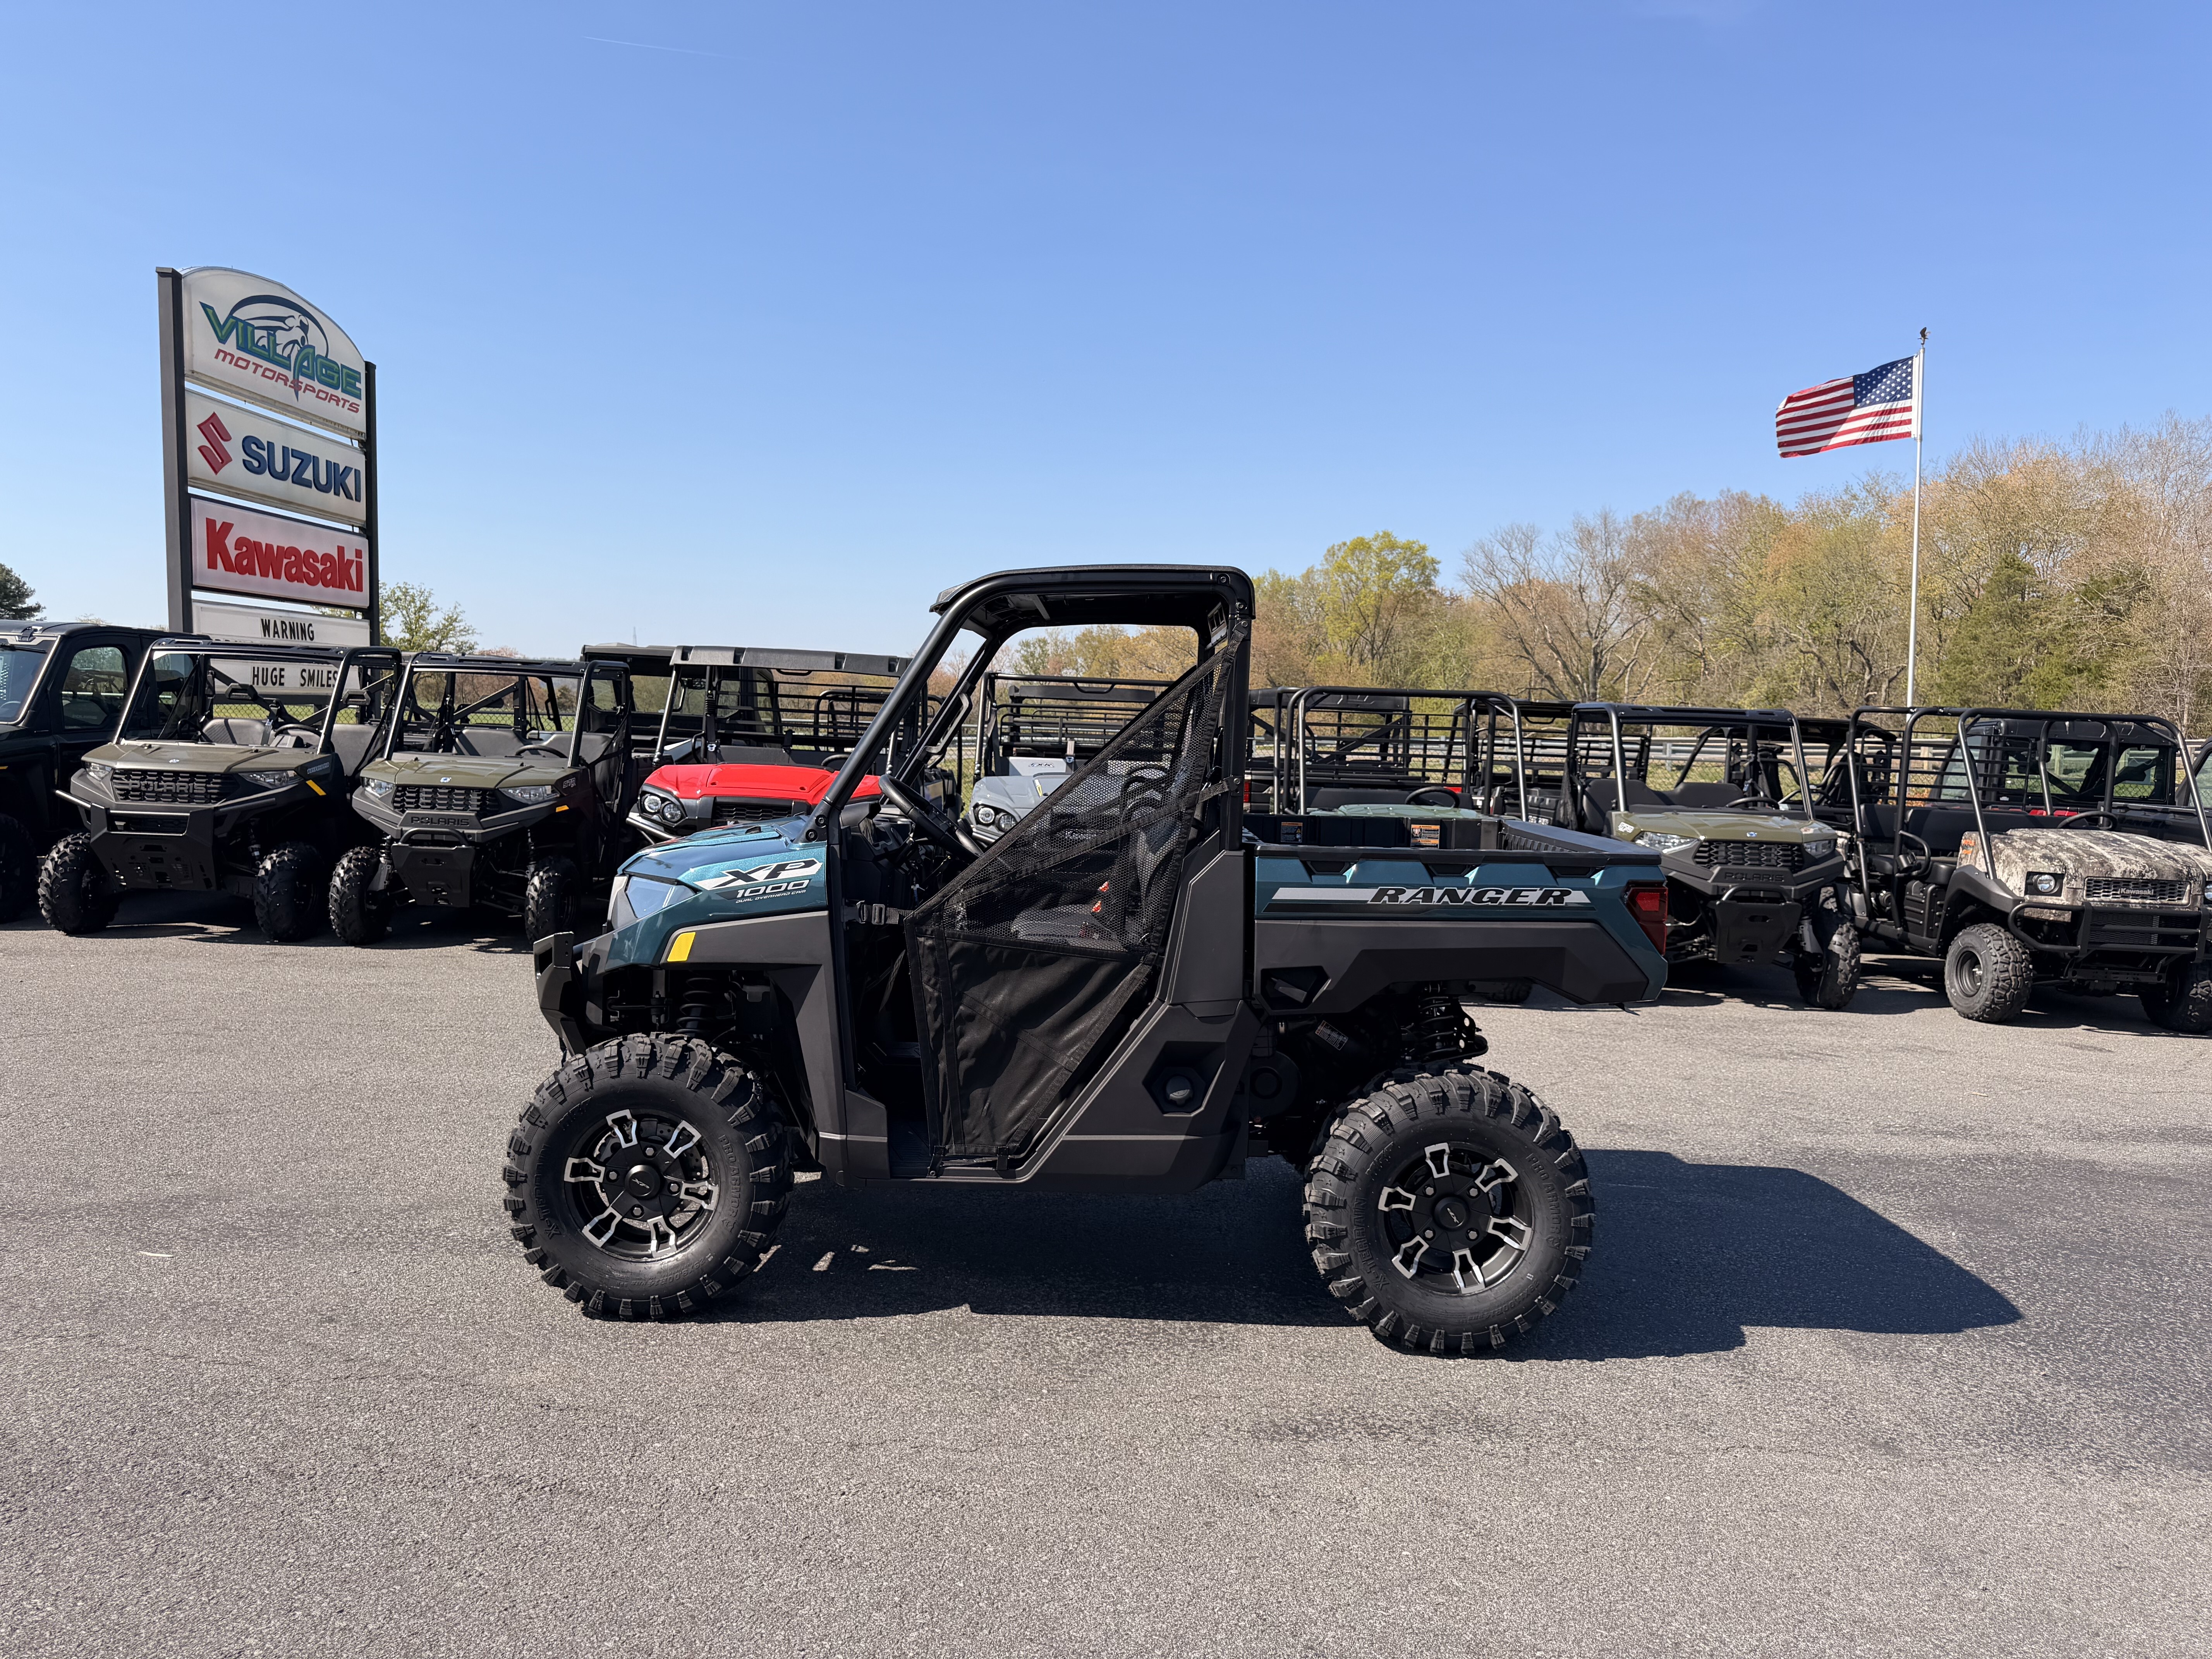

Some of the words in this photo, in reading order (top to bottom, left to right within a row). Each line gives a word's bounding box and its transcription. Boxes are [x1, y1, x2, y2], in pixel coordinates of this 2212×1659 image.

[199, 301, 362, 402] VILLAGE
[214, 349, 360, 413] MOTORSPORTS
[242, 435, 362, 503] SUZUKI
[206, 517, 363, 592] Kawasaki
[261, 618, 314, 641] WARNING
[252, 666, 285, 686] HUGE
[301, 668, 338, 688] SMILES
[129, 780, 206, 793] POLARIS
[411, 816, 469, 826] POLARIS
[711, 859, 817, 888] XP
[1724, 872, 1784, 882] POLARIS
[737, 879, 809, 898] 1000
[755, 892, 790, 900] OVERHEAD
[1367, 887, 1572, 905] RANGER
